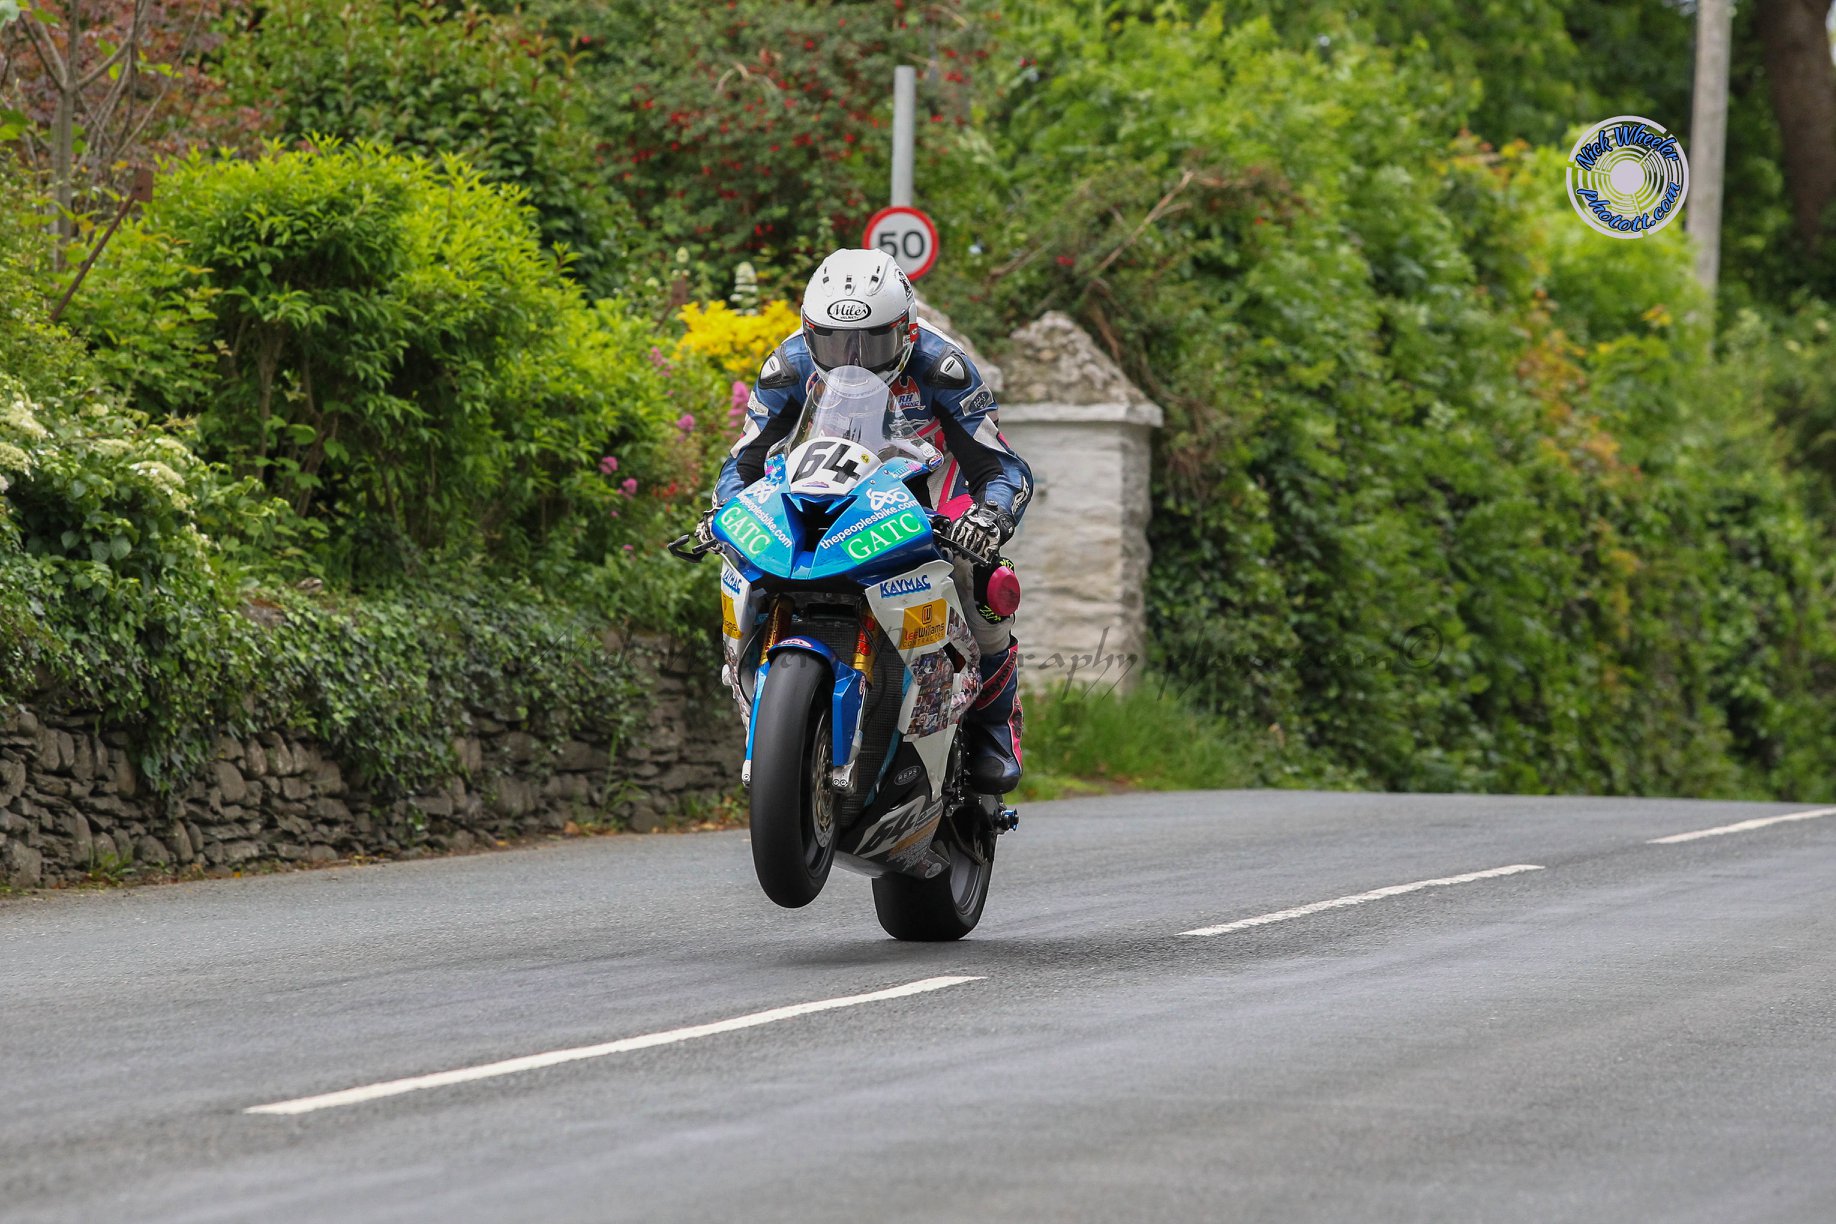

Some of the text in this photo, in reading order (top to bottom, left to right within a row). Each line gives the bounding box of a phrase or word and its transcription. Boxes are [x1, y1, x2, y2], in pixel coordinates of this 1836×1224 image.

[879, 231, 925, 259] 50
[791, 441, 861, 485] 64
[720, 507, 770, 555] GATC
[820, 499, 919, 550] thepeoplesbike.com
[848, 513, 922, 561] GATC
[880, 575, 931, 599] KAYMAC
